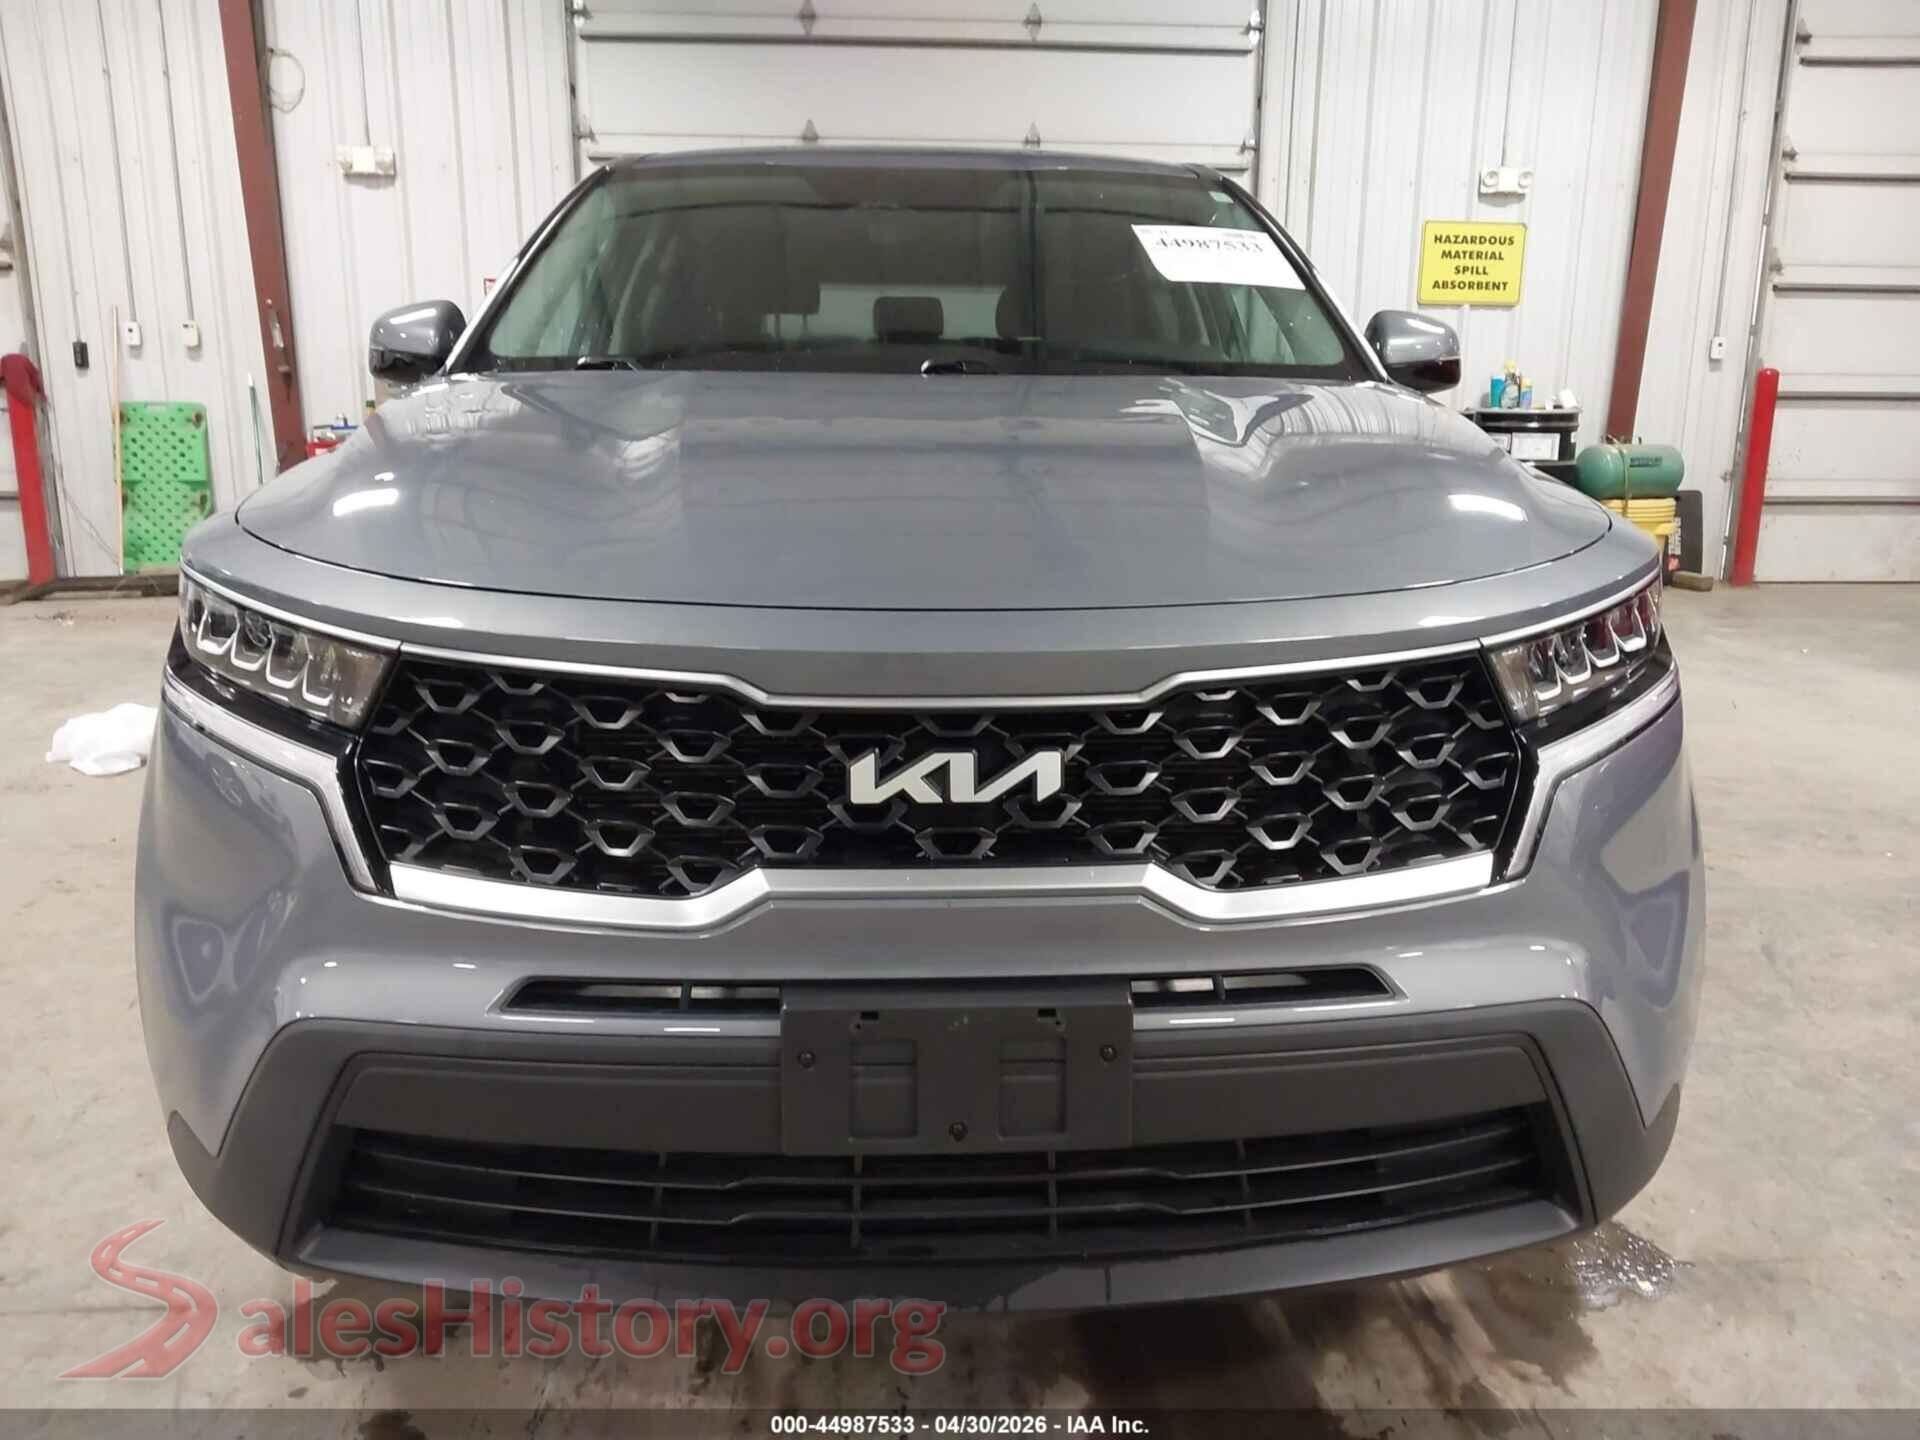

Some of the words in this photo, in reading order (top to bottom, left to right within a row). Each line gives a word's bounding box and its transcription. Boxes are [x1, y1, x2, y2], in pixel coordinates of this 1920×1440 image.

[1433, 234, 1515, 246] HAZARDOUS
[1440, 249, 1505, 261] MATERIAL
[1453, 265, 1489, 276] SPILL
[1432, 280, 1509, 291] ABSORBENT
[850, 751, 1062, 804] KIA
